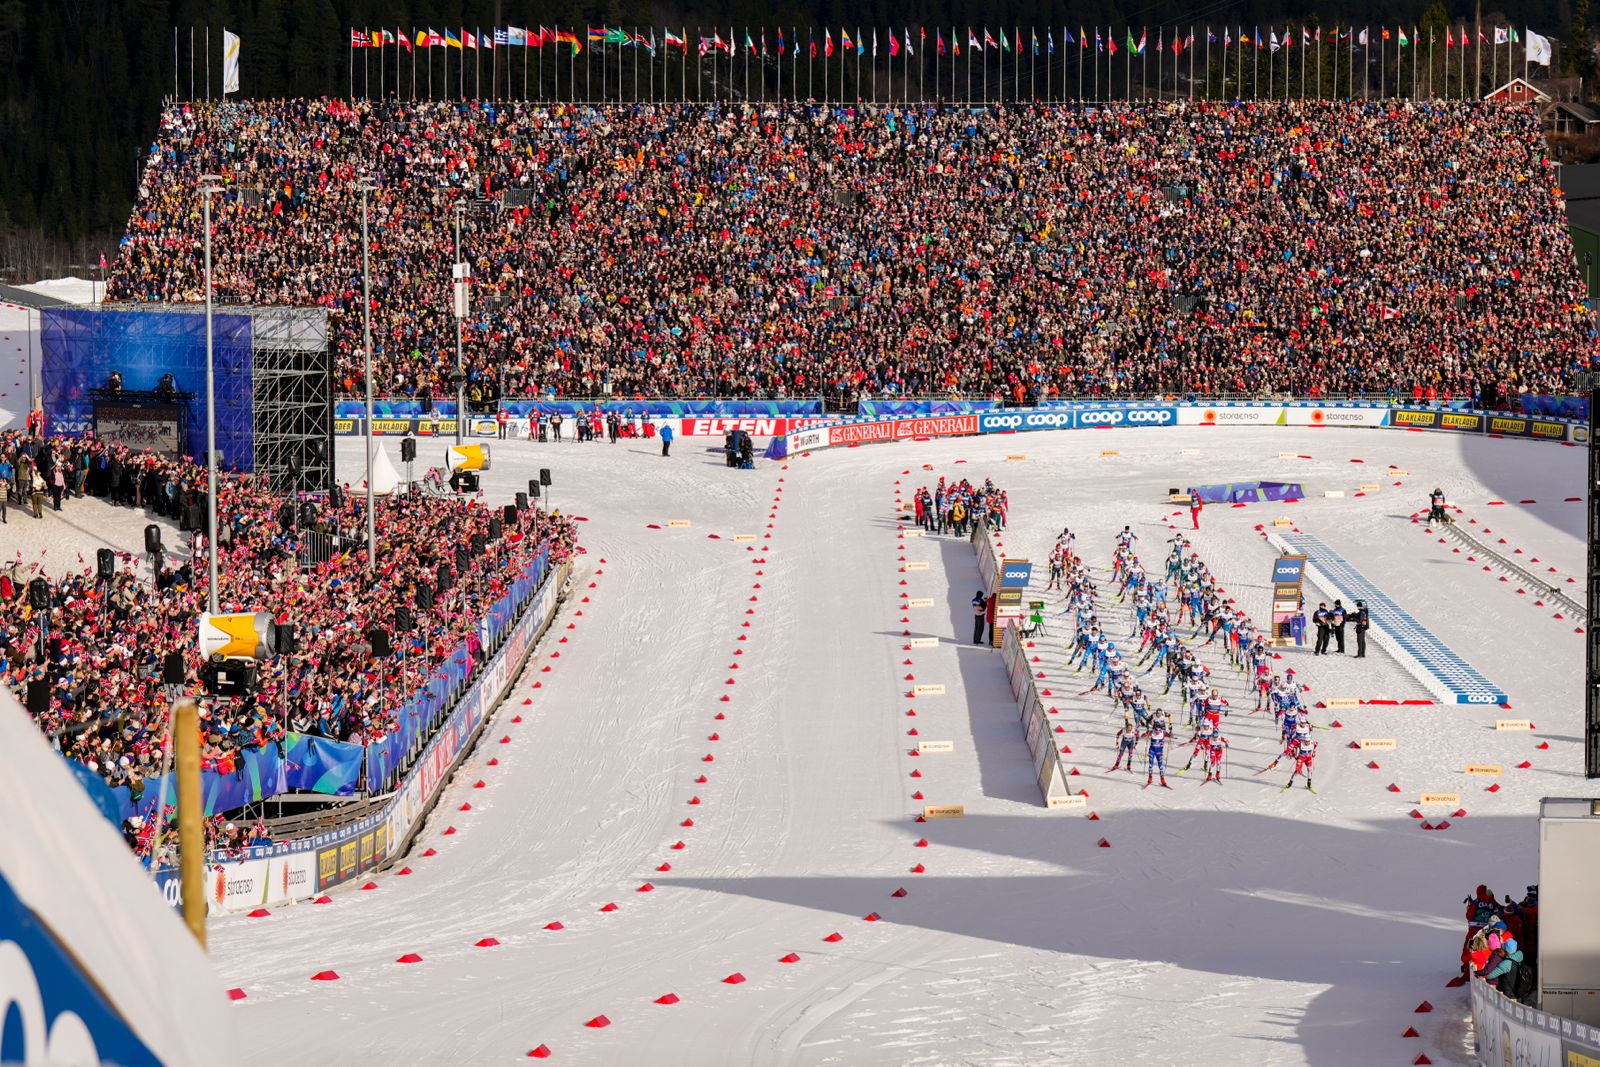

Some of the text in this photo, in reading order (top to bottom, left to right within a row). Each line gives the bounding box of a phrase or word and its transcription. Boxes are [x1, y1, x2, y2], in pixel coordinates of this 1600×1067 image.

[984, 414, 1068, 428] coop coop
[1081, 410, 1171, 424] coop coop
[1219, 410, 1259, 420] storaenso
[1326, 412, 1363, 421] storaenso
[692, 420, 776, 436] ELTEN
[914, 415, 974, 434] GENERALI
[843, 422, 890, 442] GENERALI
[1468, 694, 1498, 704] coop
